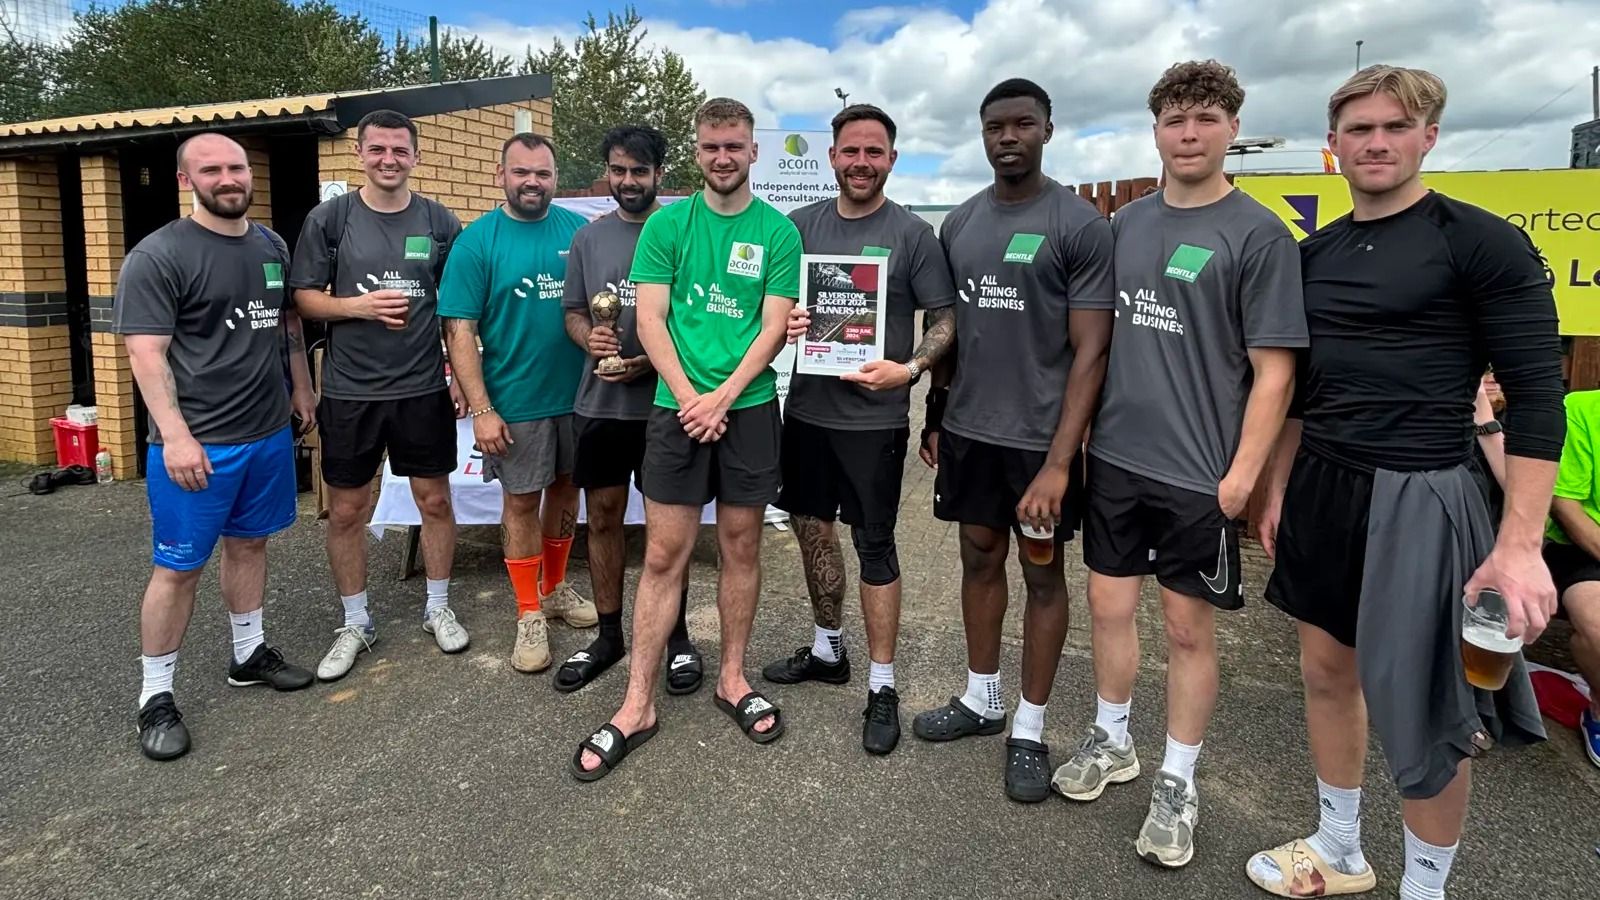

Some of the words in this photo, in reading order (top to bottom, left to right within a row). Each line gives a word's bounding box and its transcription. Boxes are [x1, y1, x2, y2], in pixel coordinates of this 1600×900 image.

[778, 158, 819, 170] acorn
[752, 182, 820, 192] Independent
[729, 260, 760, 272] acorn
[383, 271, 401, 279] ALL
[537, 273, 554, 282] ALL
[1166, 266, 1197, 279] BECHTLE
[980, 275, 998, 285] ALL
[817, 291, 867, 300] SILVERSTONE
[980, 286, 1018, 298] THINGS
[1134, 288, 1157, 302] ALL
[247, 300, 265, 310] ALL
[978, 297, 1025, 311] BUSINESS
[816, 306, 854, 314] RUNNERS
[855, 307, 868, 315] UP
